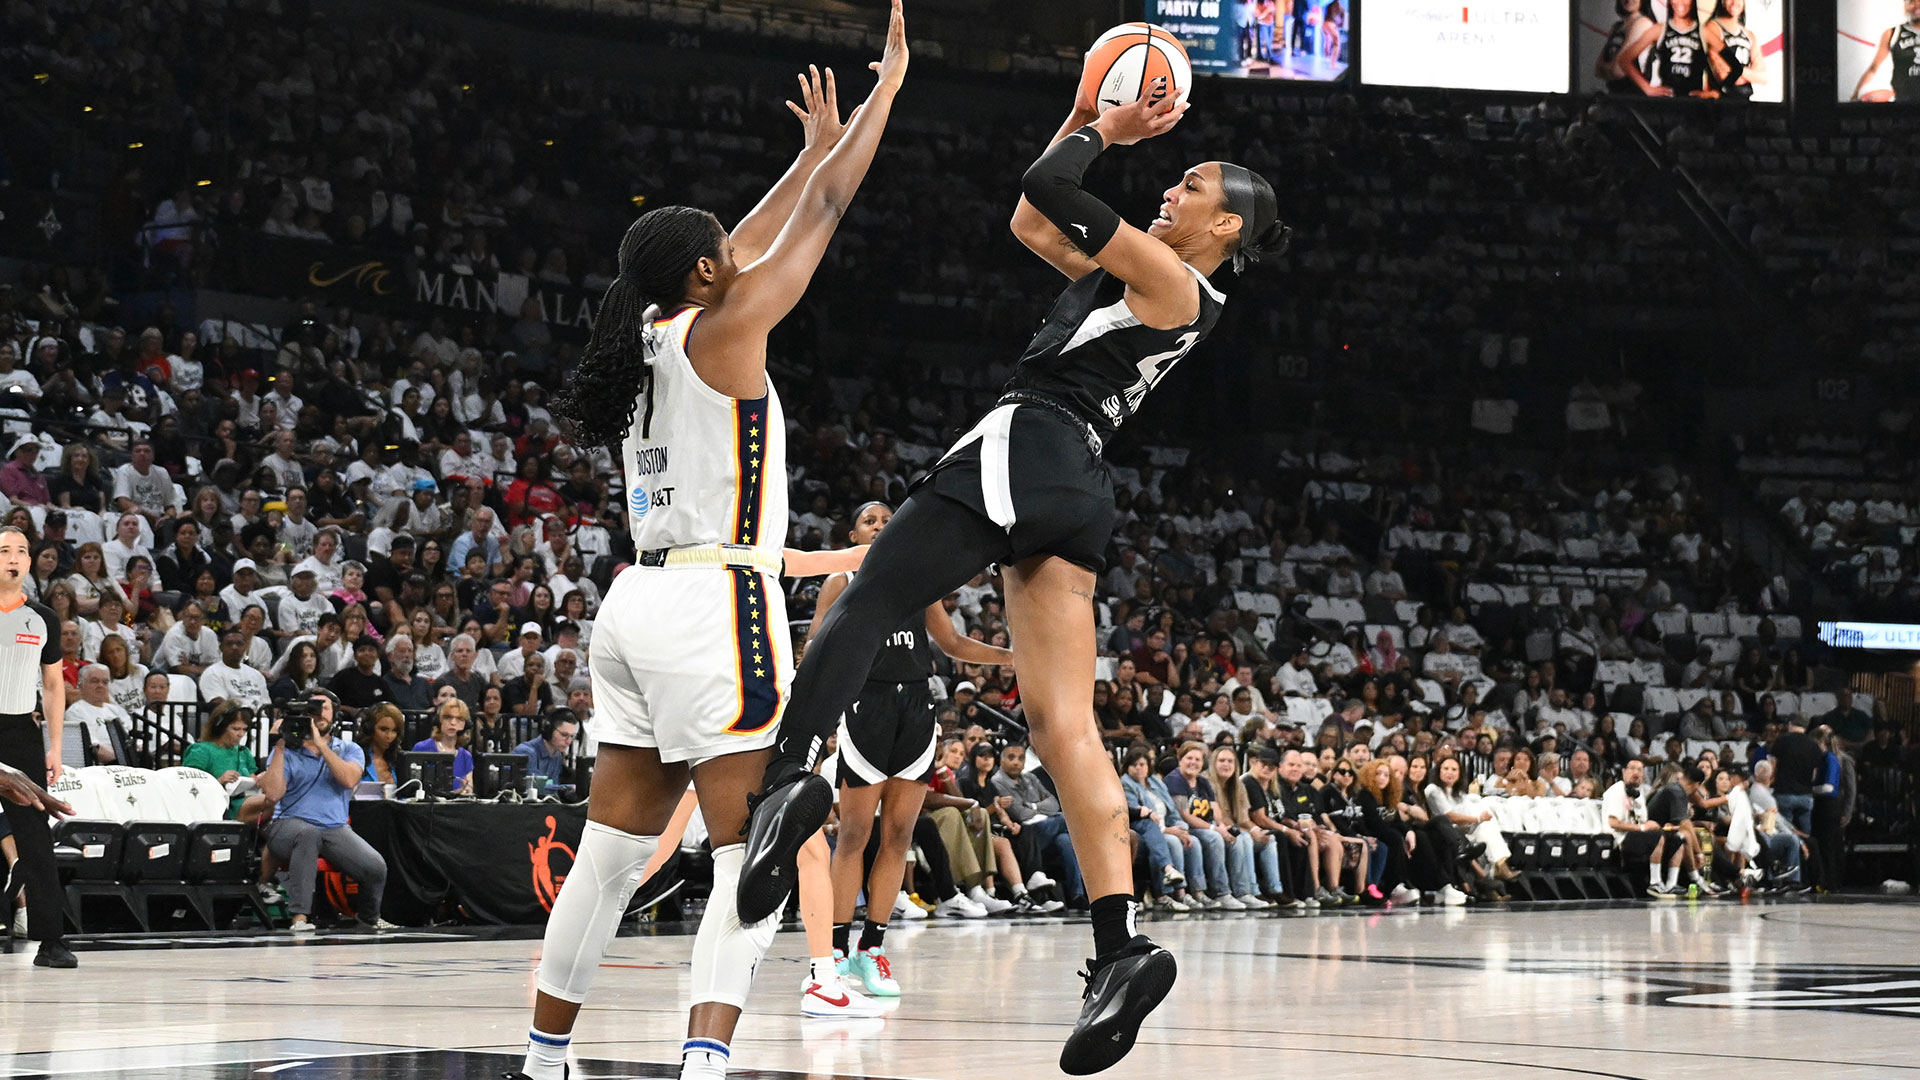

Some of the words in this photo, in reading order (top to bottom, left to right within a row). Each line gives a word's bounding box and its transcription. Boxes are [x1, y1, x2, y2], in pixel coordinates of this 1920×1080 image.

[1157, 1, 1199, 17] PARTY
[1200, 2, 1220, 18] ON
[1436, 31, 1496, 45] ARENA
[1670, 46, 1692, 64] 22
[636, 446, 668, 476] BOSTON
[114, 774, 147, 788] Stakes
